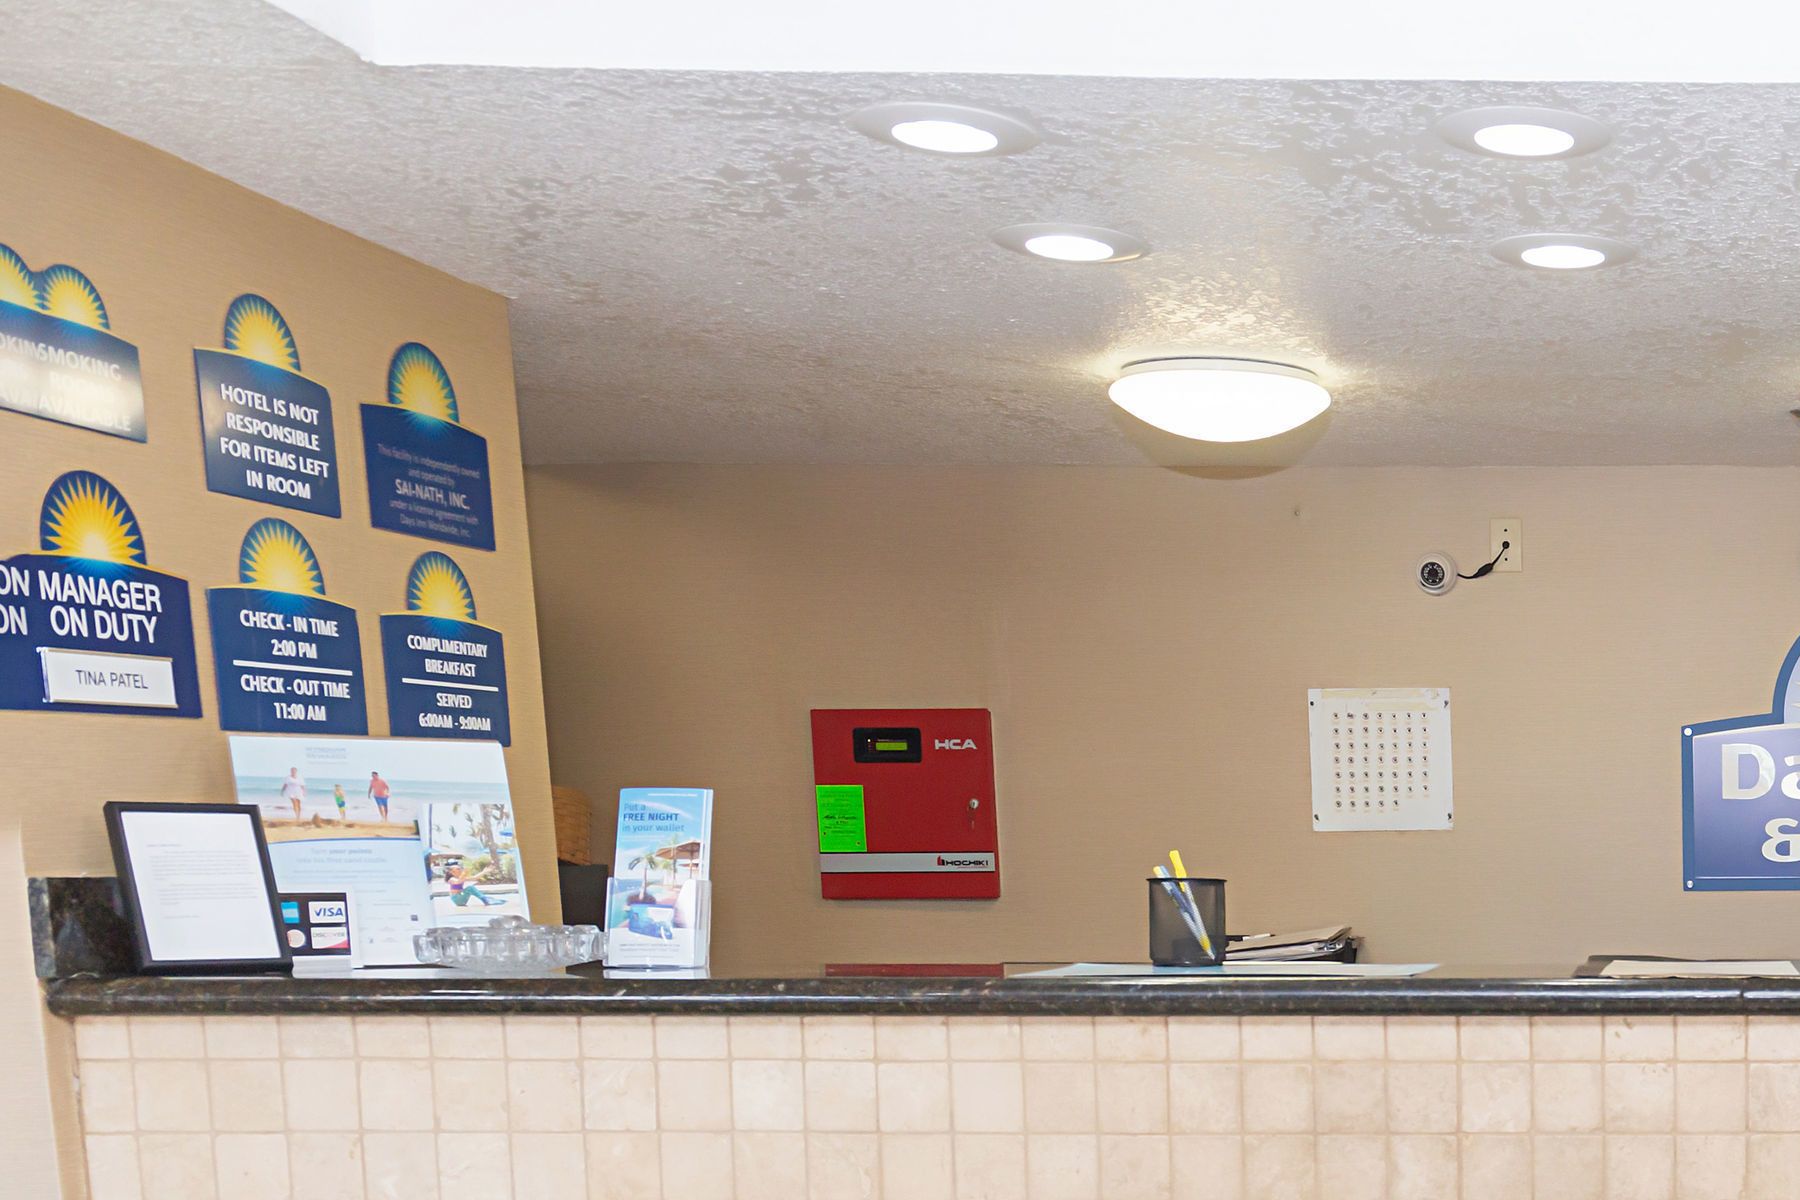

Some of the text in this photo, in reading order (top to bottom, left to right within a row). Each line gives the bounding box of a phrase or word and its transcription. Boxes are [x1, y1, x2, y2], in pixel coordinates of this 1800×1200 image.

[38, 342, 121, 380] SMOKING
[220, 383, 319, 425] HOTEL IS NOT
[225, 412, 321, 451] RESPONSIBLE
[220, 437, 329, 478] FOR ITEMS LEFT
[246, 469, 311, 500] IN ROOM
[395, 478, 470, 510] SAI-NATH, INC.
[38, 569, 162, 613] MANAGER
[50, 605, 157, 644] ON DUTY
[239, 608, 285, 631] CHECK
[292, 615, 308, 633] IN
[308, 617, 339, 637] TIME
[270, 638, 318, 659] 2:00 PM
[407, 634, 487, 658] COMPLIMENTARY
[75, 669, 149, 689] TINA PATEL
[424, 658, 477, 677] BREAKFAST
[240, 673, 285, 694] CHECK
[293, 678, 320, 697] OUT
[320, 680, 351, 699] TIME
[273, 702, 327, 721] 11:00 AM
[436, 692, 472, 709] SERVED
[418, 712, 453, 729] 6:00AM
[459, 715, 491, 731] 9:00AM
[934, 738, 977, 750] HCA
[623, 812, 680, 821] FREE NIGHT
[314, 907, 343, 917] VISA
